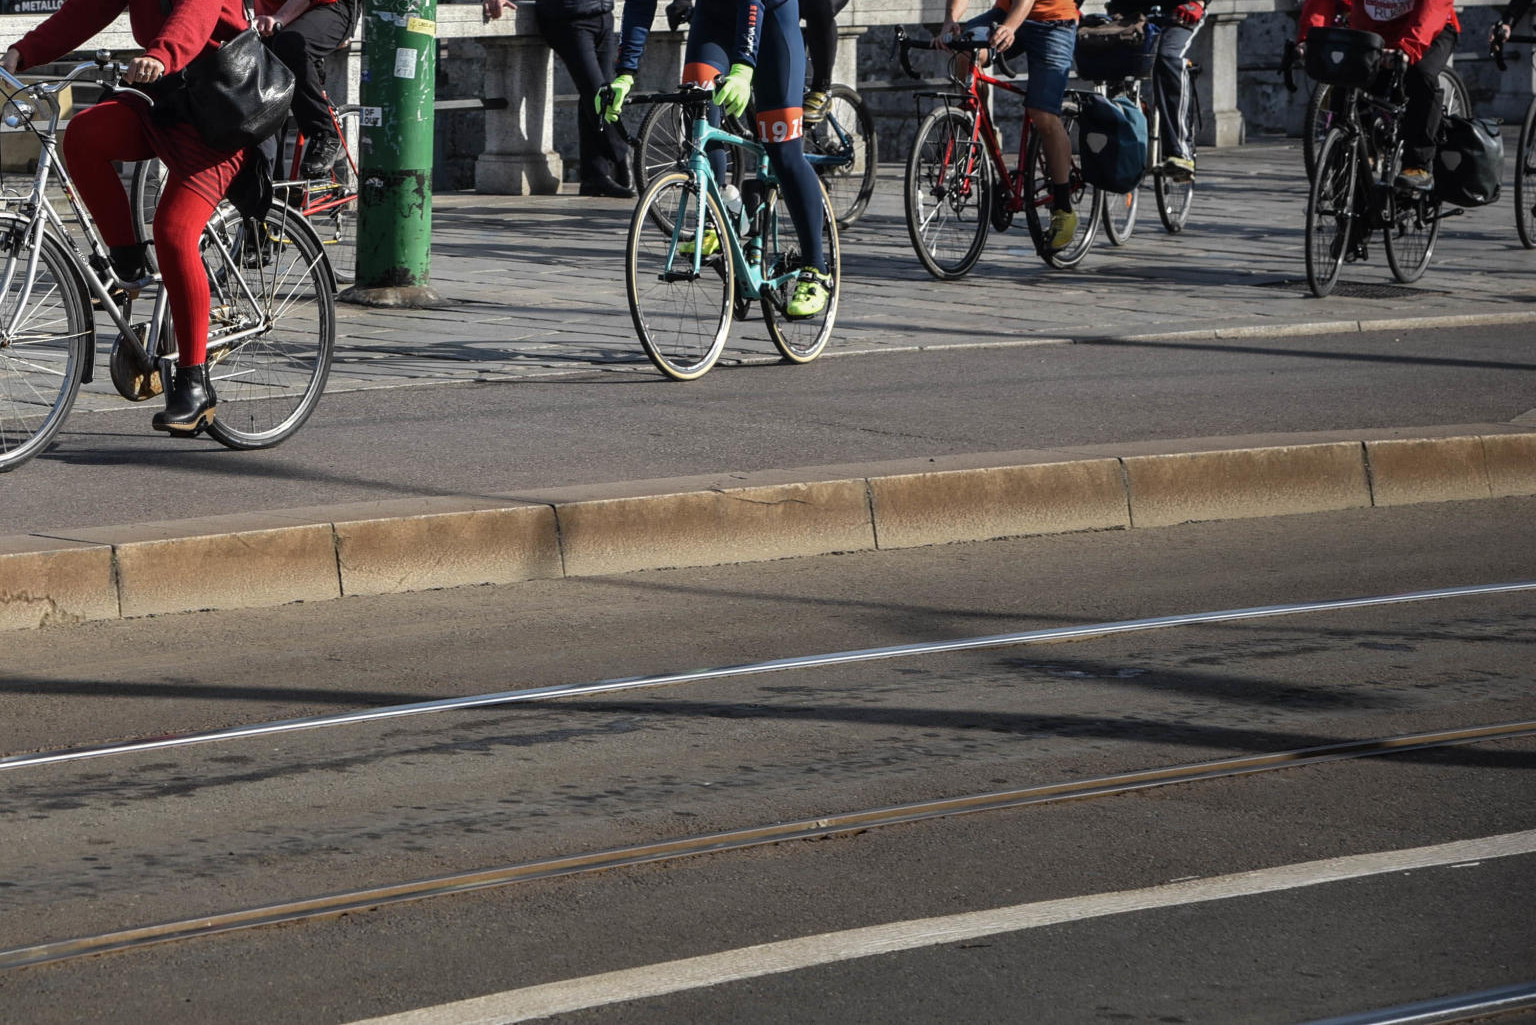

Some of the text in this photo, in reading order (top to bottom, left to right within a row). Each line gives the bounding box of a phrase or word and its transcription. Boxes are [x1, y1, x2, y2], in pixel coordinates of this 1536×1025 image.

[14, 0, 65, 12] e METALLO
[759, 115, 803, 143] 191
